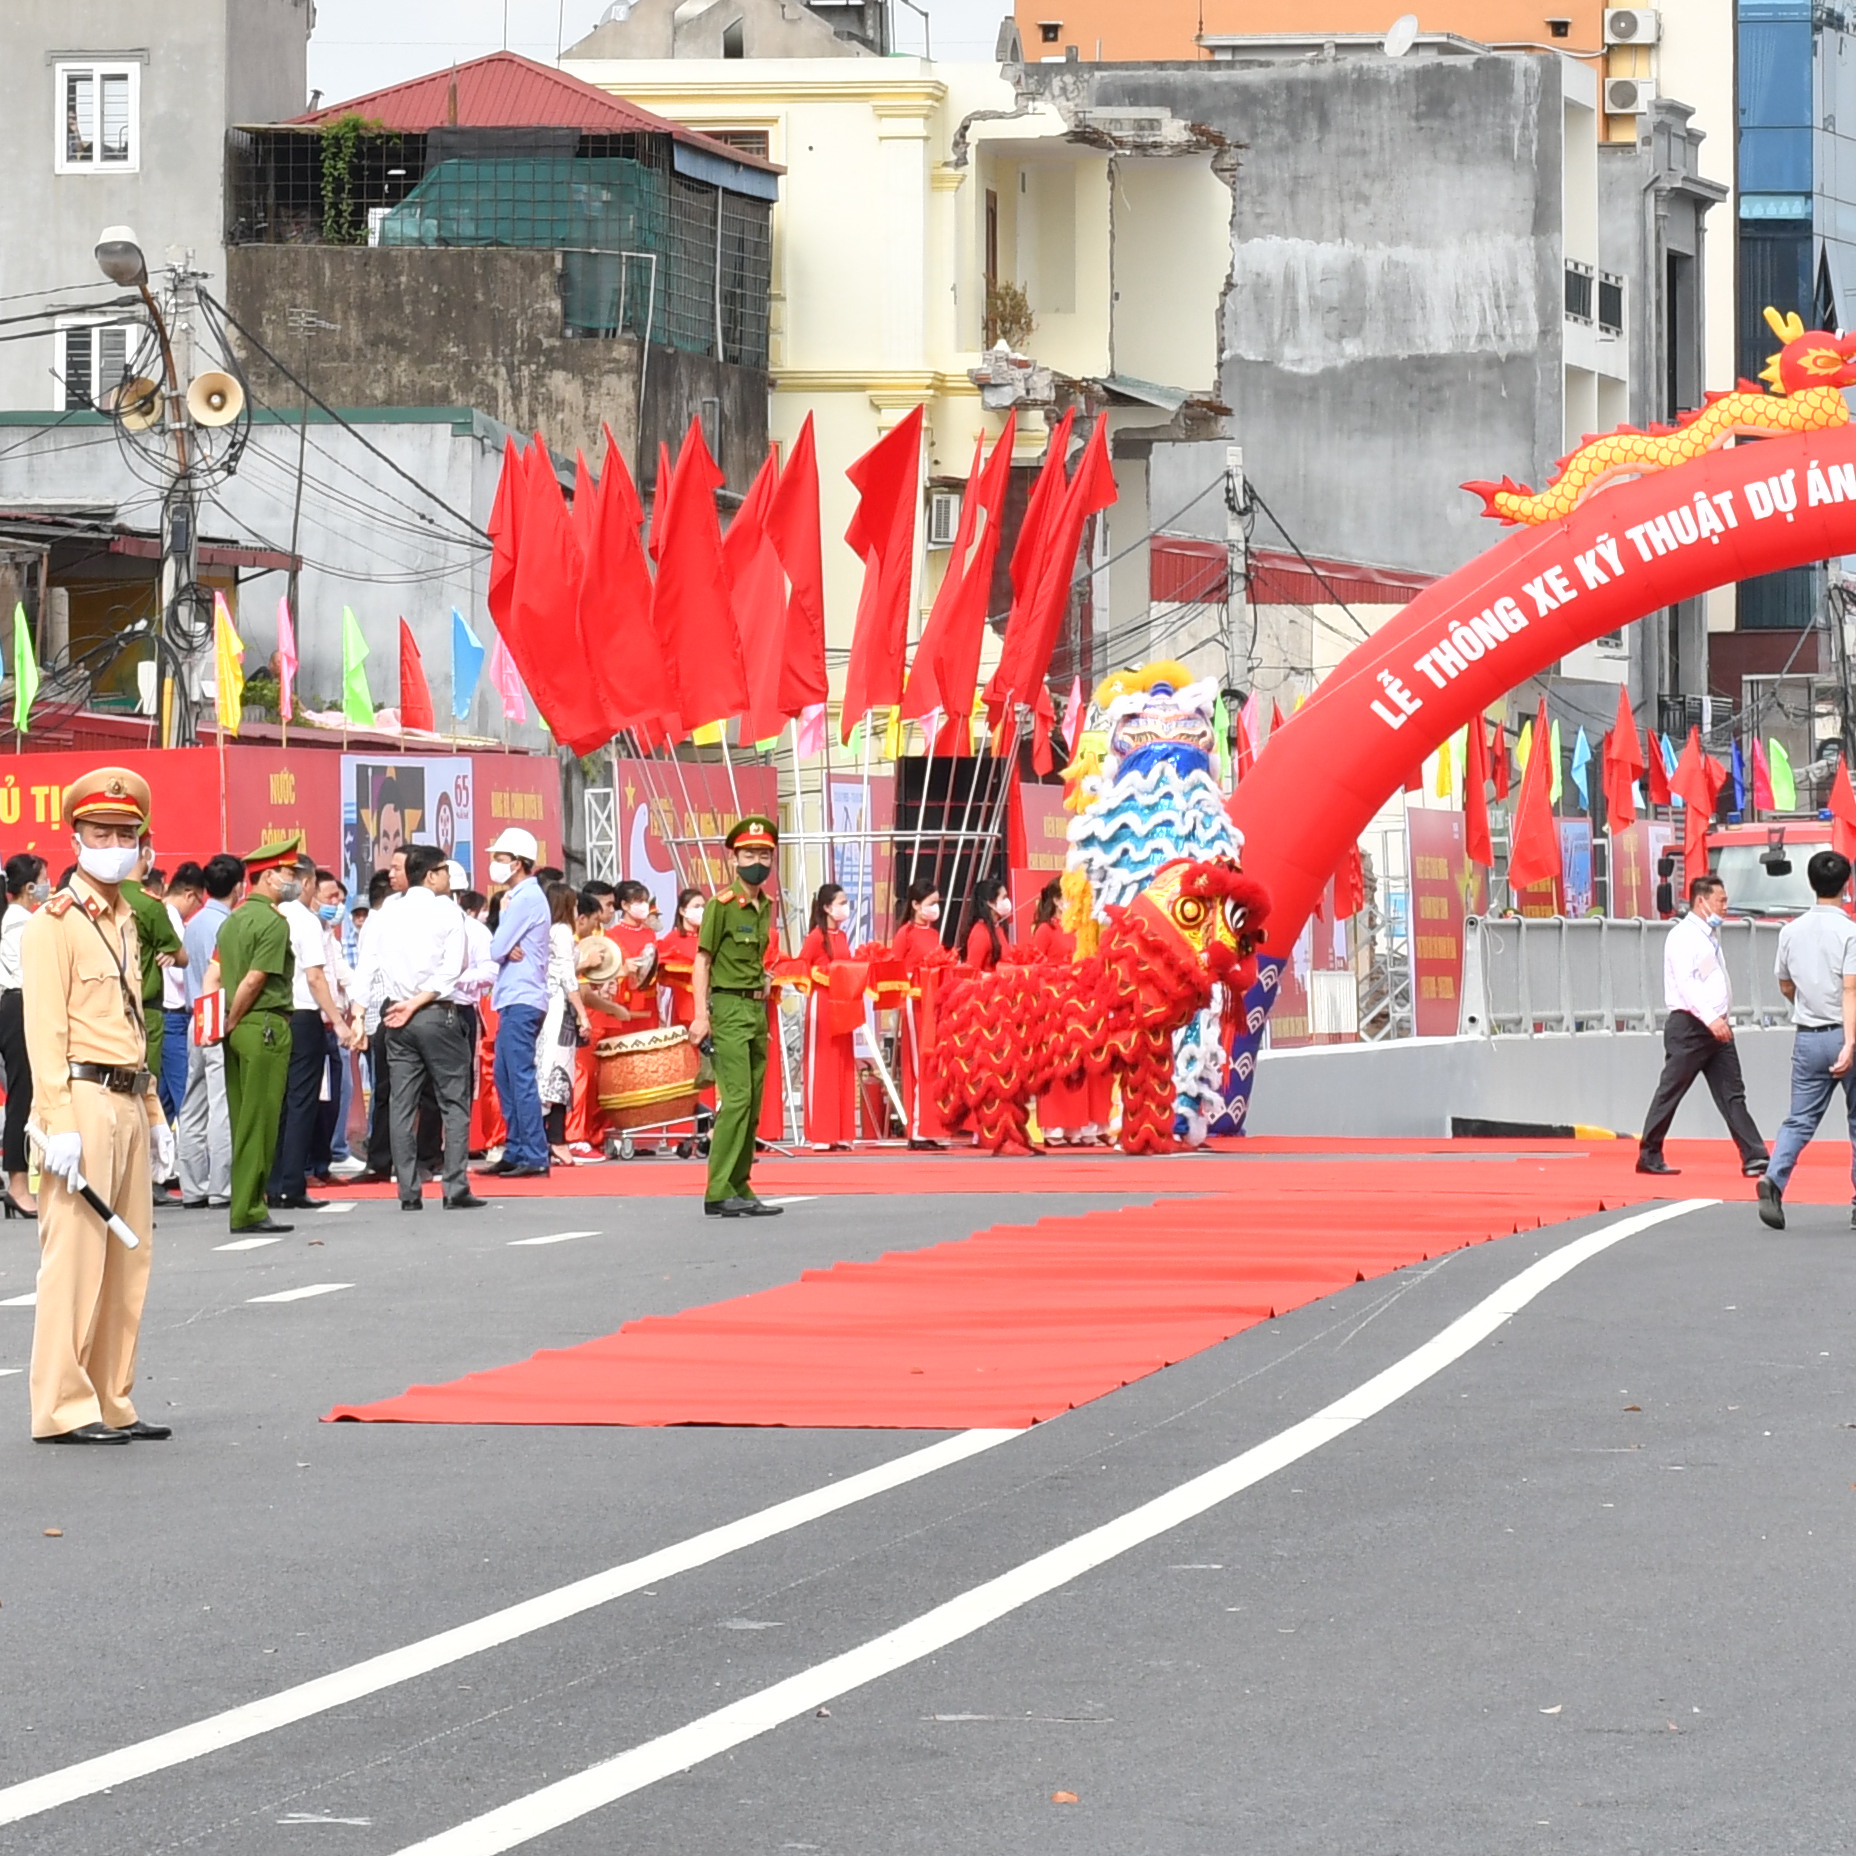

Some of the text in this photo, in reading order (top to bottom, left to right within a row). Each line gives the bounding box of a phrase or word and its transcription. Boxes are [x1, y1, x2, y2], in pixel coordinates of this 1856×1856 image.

[1370, 668, 1423, 731] LỄ
[1413, 595, 1529, 690] THÔNG
[1521, 564, 1578, 618] XE
[1573, 532, 1625, 591] KỸ
[1625, 490, 1739, 563] THUẬT
[1744, 468, 1798, 523] DỰ
[270, 768, 296, 805] NƯỚC
[454, 774, 469, 808] 65
